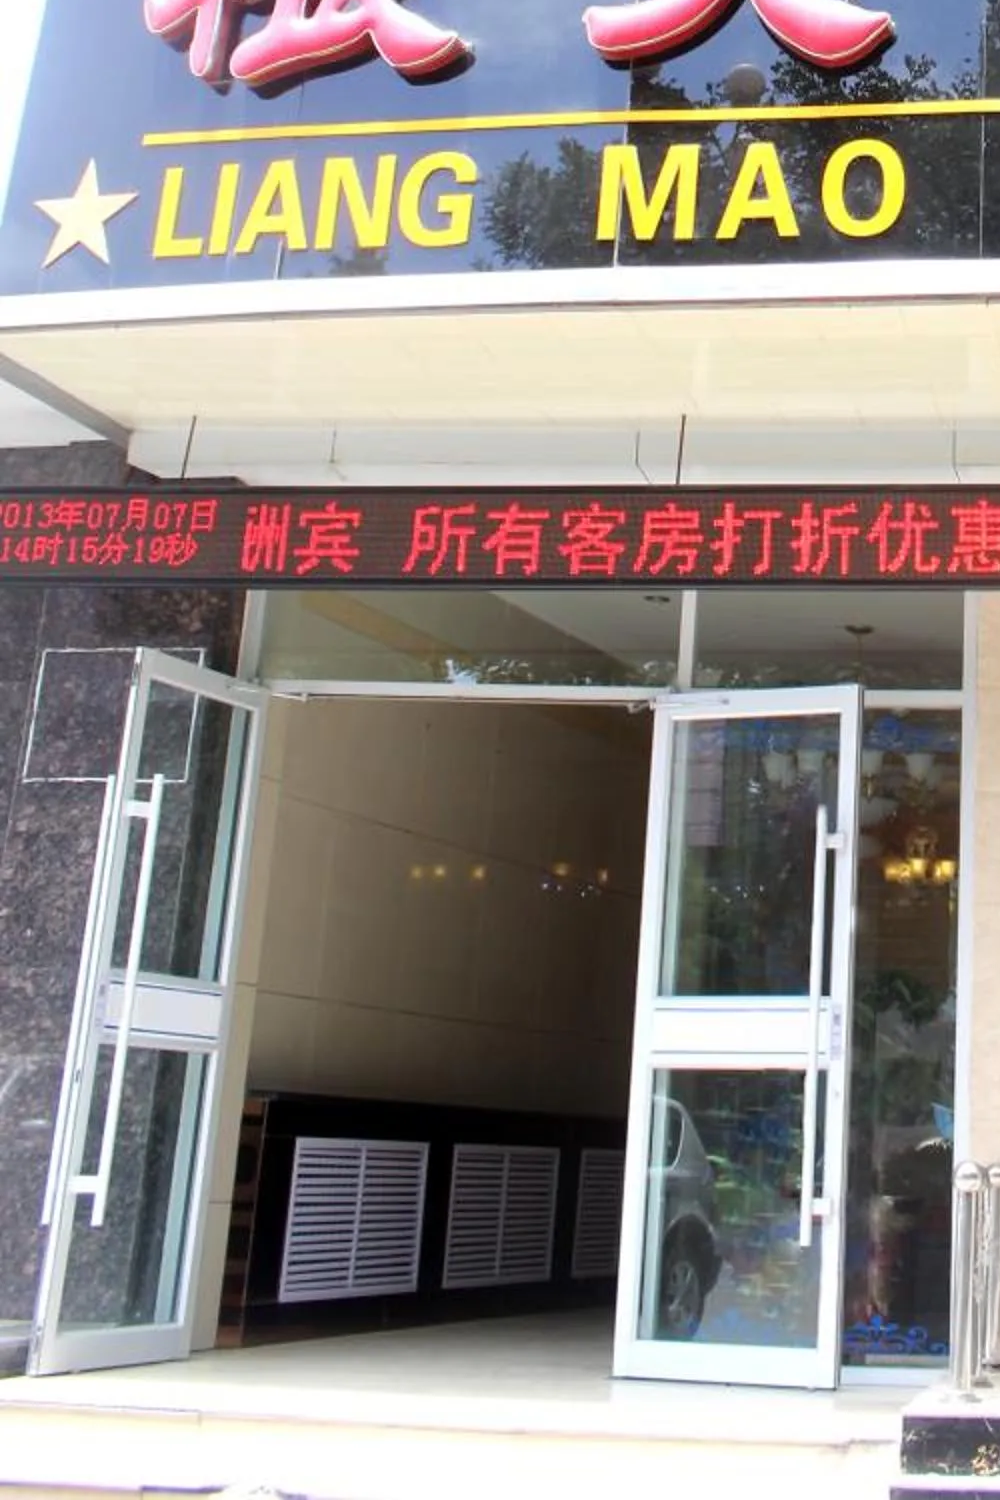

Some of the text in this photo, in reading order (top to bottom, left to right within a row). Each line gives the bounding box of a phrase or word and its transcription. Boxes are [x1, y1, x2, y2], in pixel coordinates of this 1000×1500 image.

[150, 150, 479, 260] LIANG
[595, 137, 907, 242] MAO
[0, 499, 217, 531] 013年07月07日
